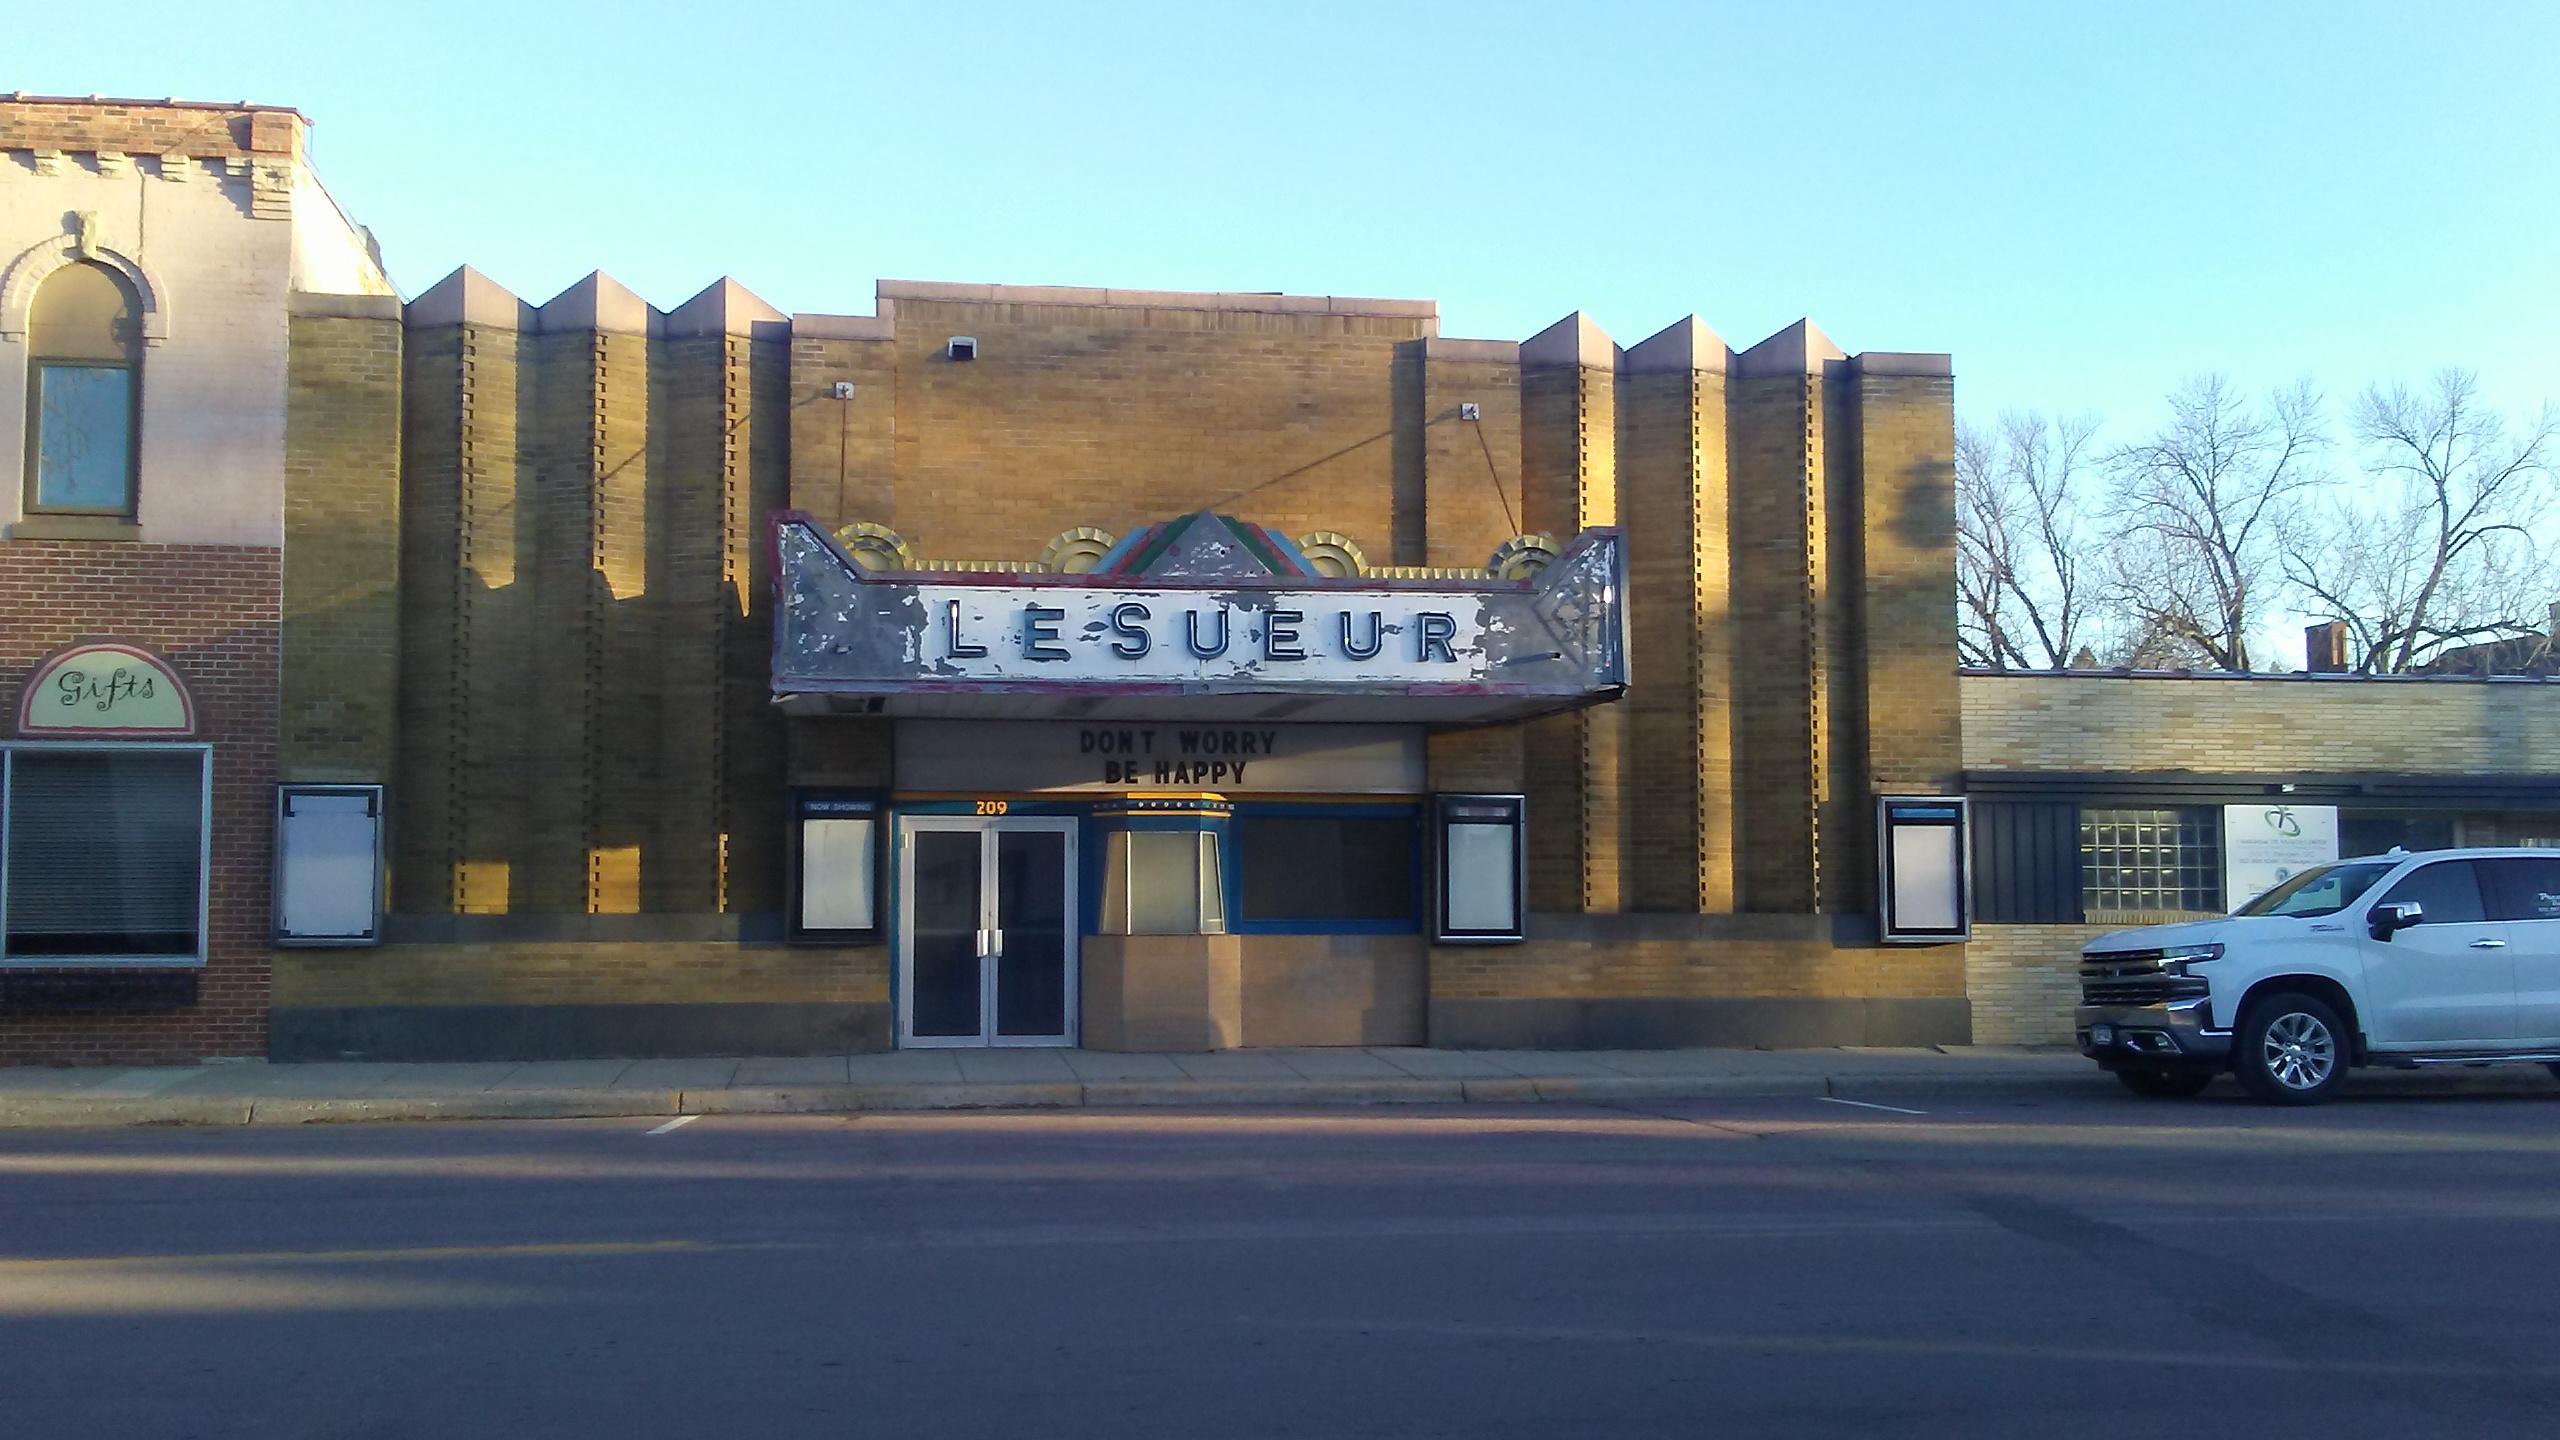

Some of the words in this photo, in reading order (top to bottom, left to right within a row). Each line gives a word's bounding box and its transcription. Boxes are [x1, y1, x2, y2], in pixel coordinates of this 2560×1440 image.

[58, 667, 154, 712] Gifts
[1179, 730, 1275, 754] WORRY
[1105, 761, 1138, 784] BE
[1154, 761, 1246, 784] HAPPY
[976, 800, 1007, 815] 209
